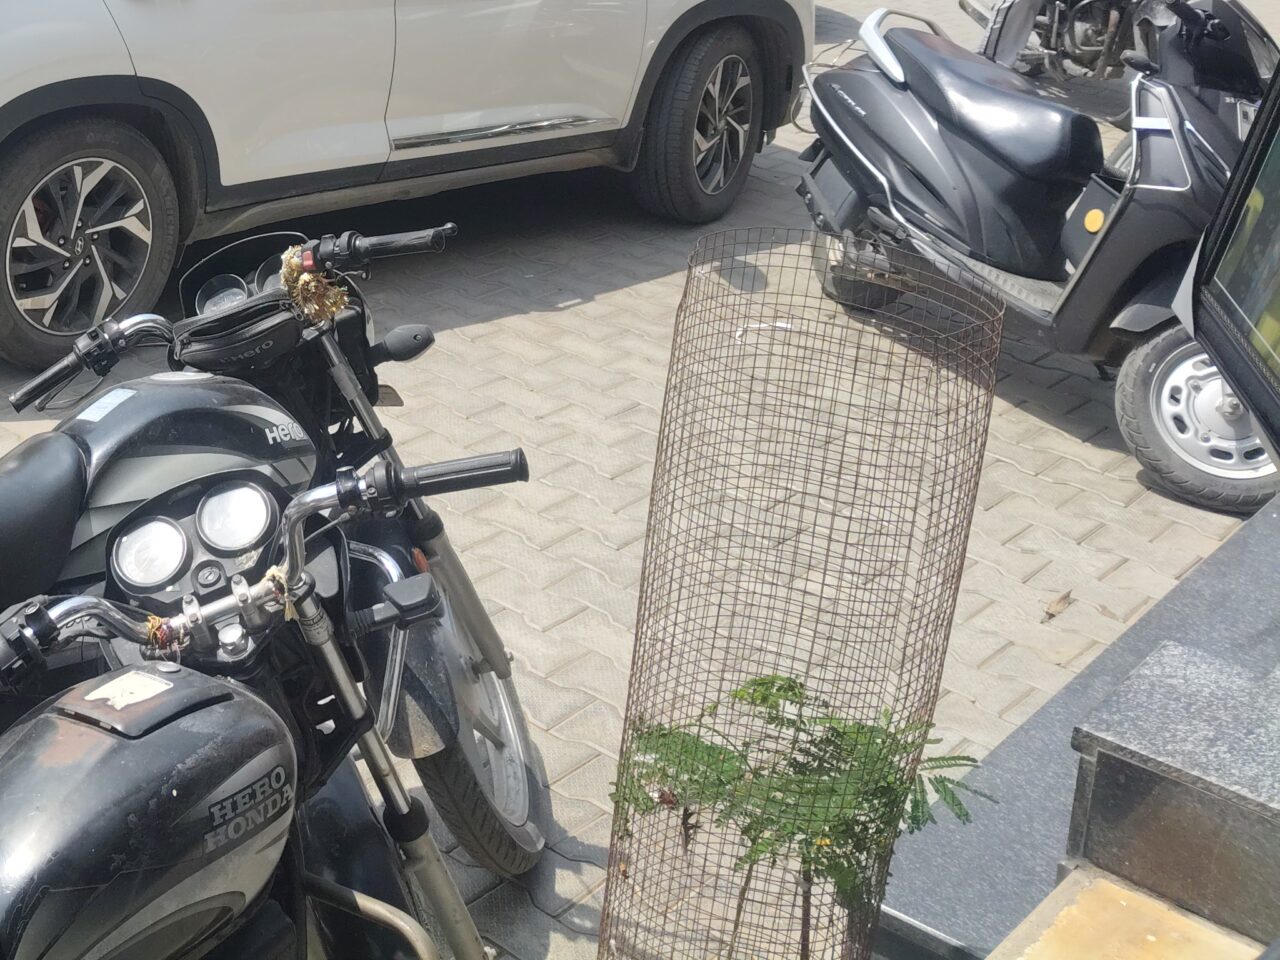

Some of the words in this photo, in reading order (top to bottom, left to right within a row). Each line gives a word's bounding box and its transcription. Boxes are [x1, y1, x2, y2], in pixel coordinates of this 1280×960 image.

[265, 420, 305, 444] Hero
[204, 783, 295, 854] HONDA
[210, 766, 287, 827] HERO
